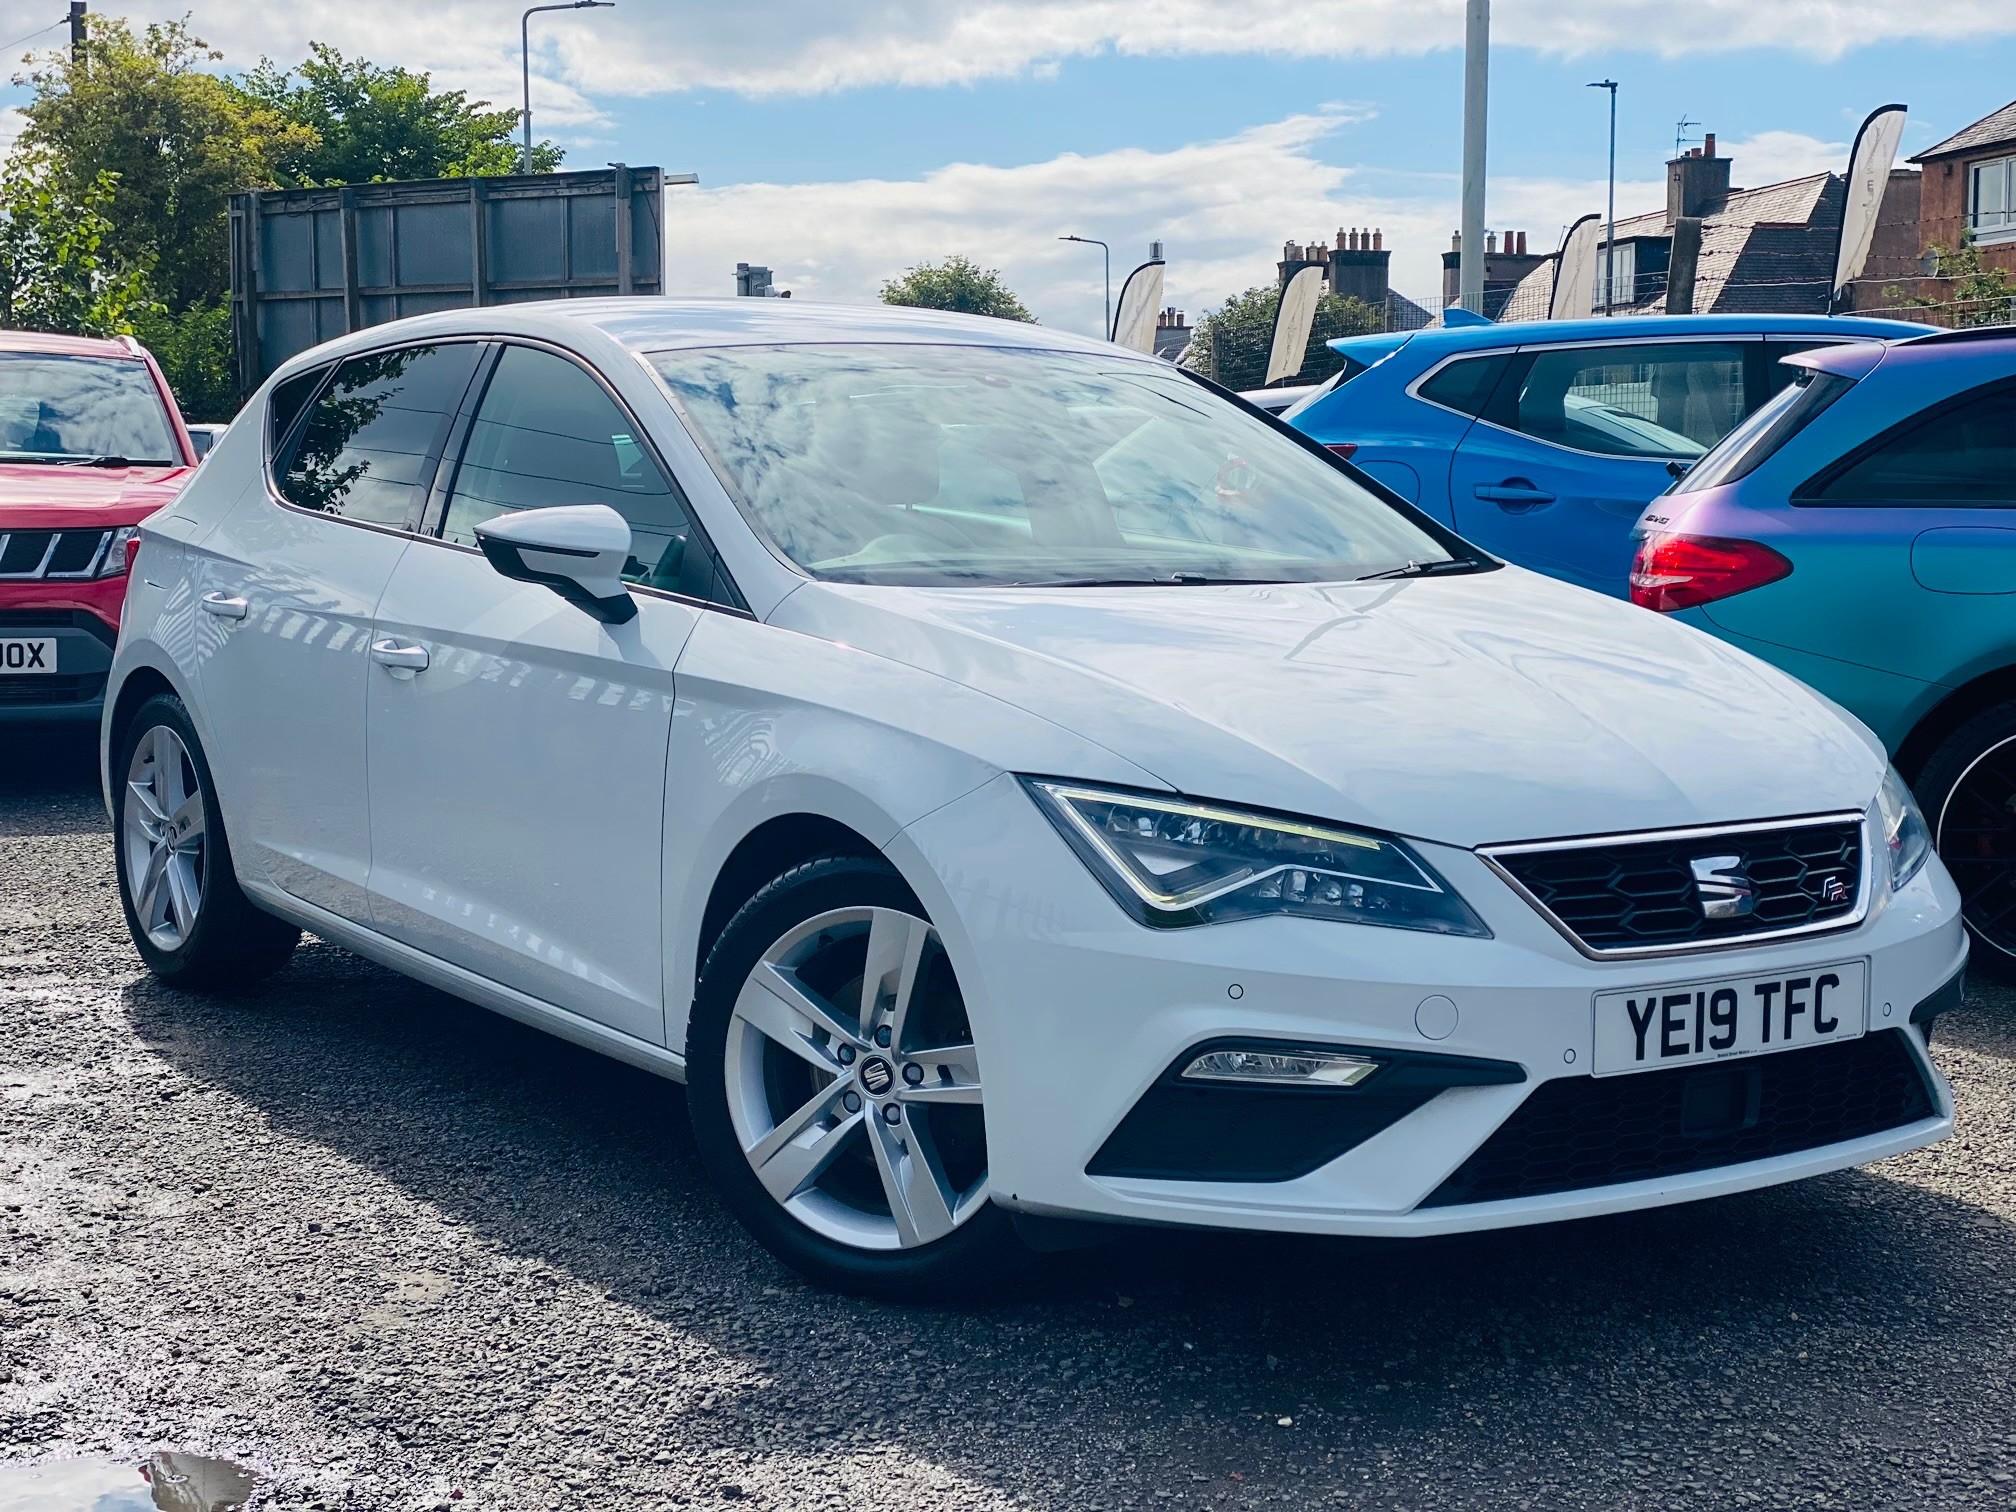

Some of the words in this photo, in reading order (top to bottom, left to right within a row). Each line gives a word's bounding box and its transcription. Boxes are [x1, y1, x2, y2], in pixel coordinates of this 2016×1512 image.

[0, 643, 45, 668] OX
[1626, 988, 1738, 1061] YE19
[1754, 973, 1840, 1044] TFC
